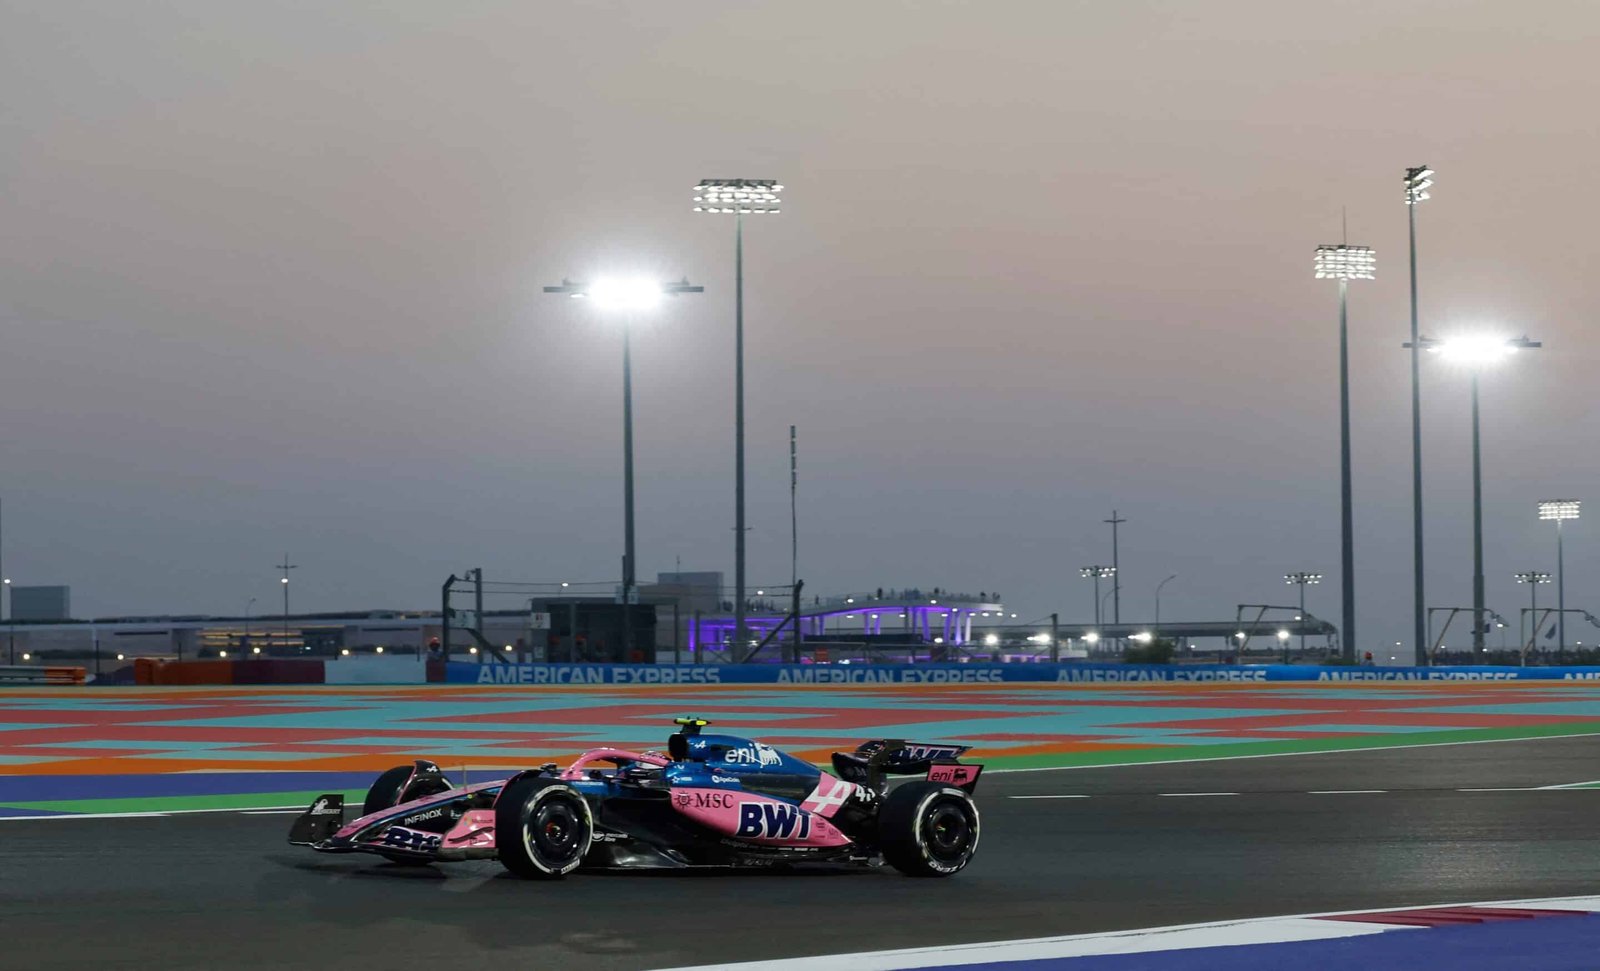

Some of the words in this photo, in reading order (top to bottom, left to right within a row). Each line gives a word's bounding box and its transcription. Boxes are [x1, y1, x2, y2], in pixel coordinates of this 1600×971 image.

[477, 666, 604, 683] AMERICAN
[612, 667, 720, 683] EXPRESS
[776, 669, 894, 684] AMERICAN
[902, 669, 1004, 683] EXPRESS
[724, 743, 755, 763] eni
[931, 769, 952, 781] eni
[695, 792, 734, 809] MSC
[404, 808, 442, 826] INFINOX
[735, 802, 813, 840] BWT
